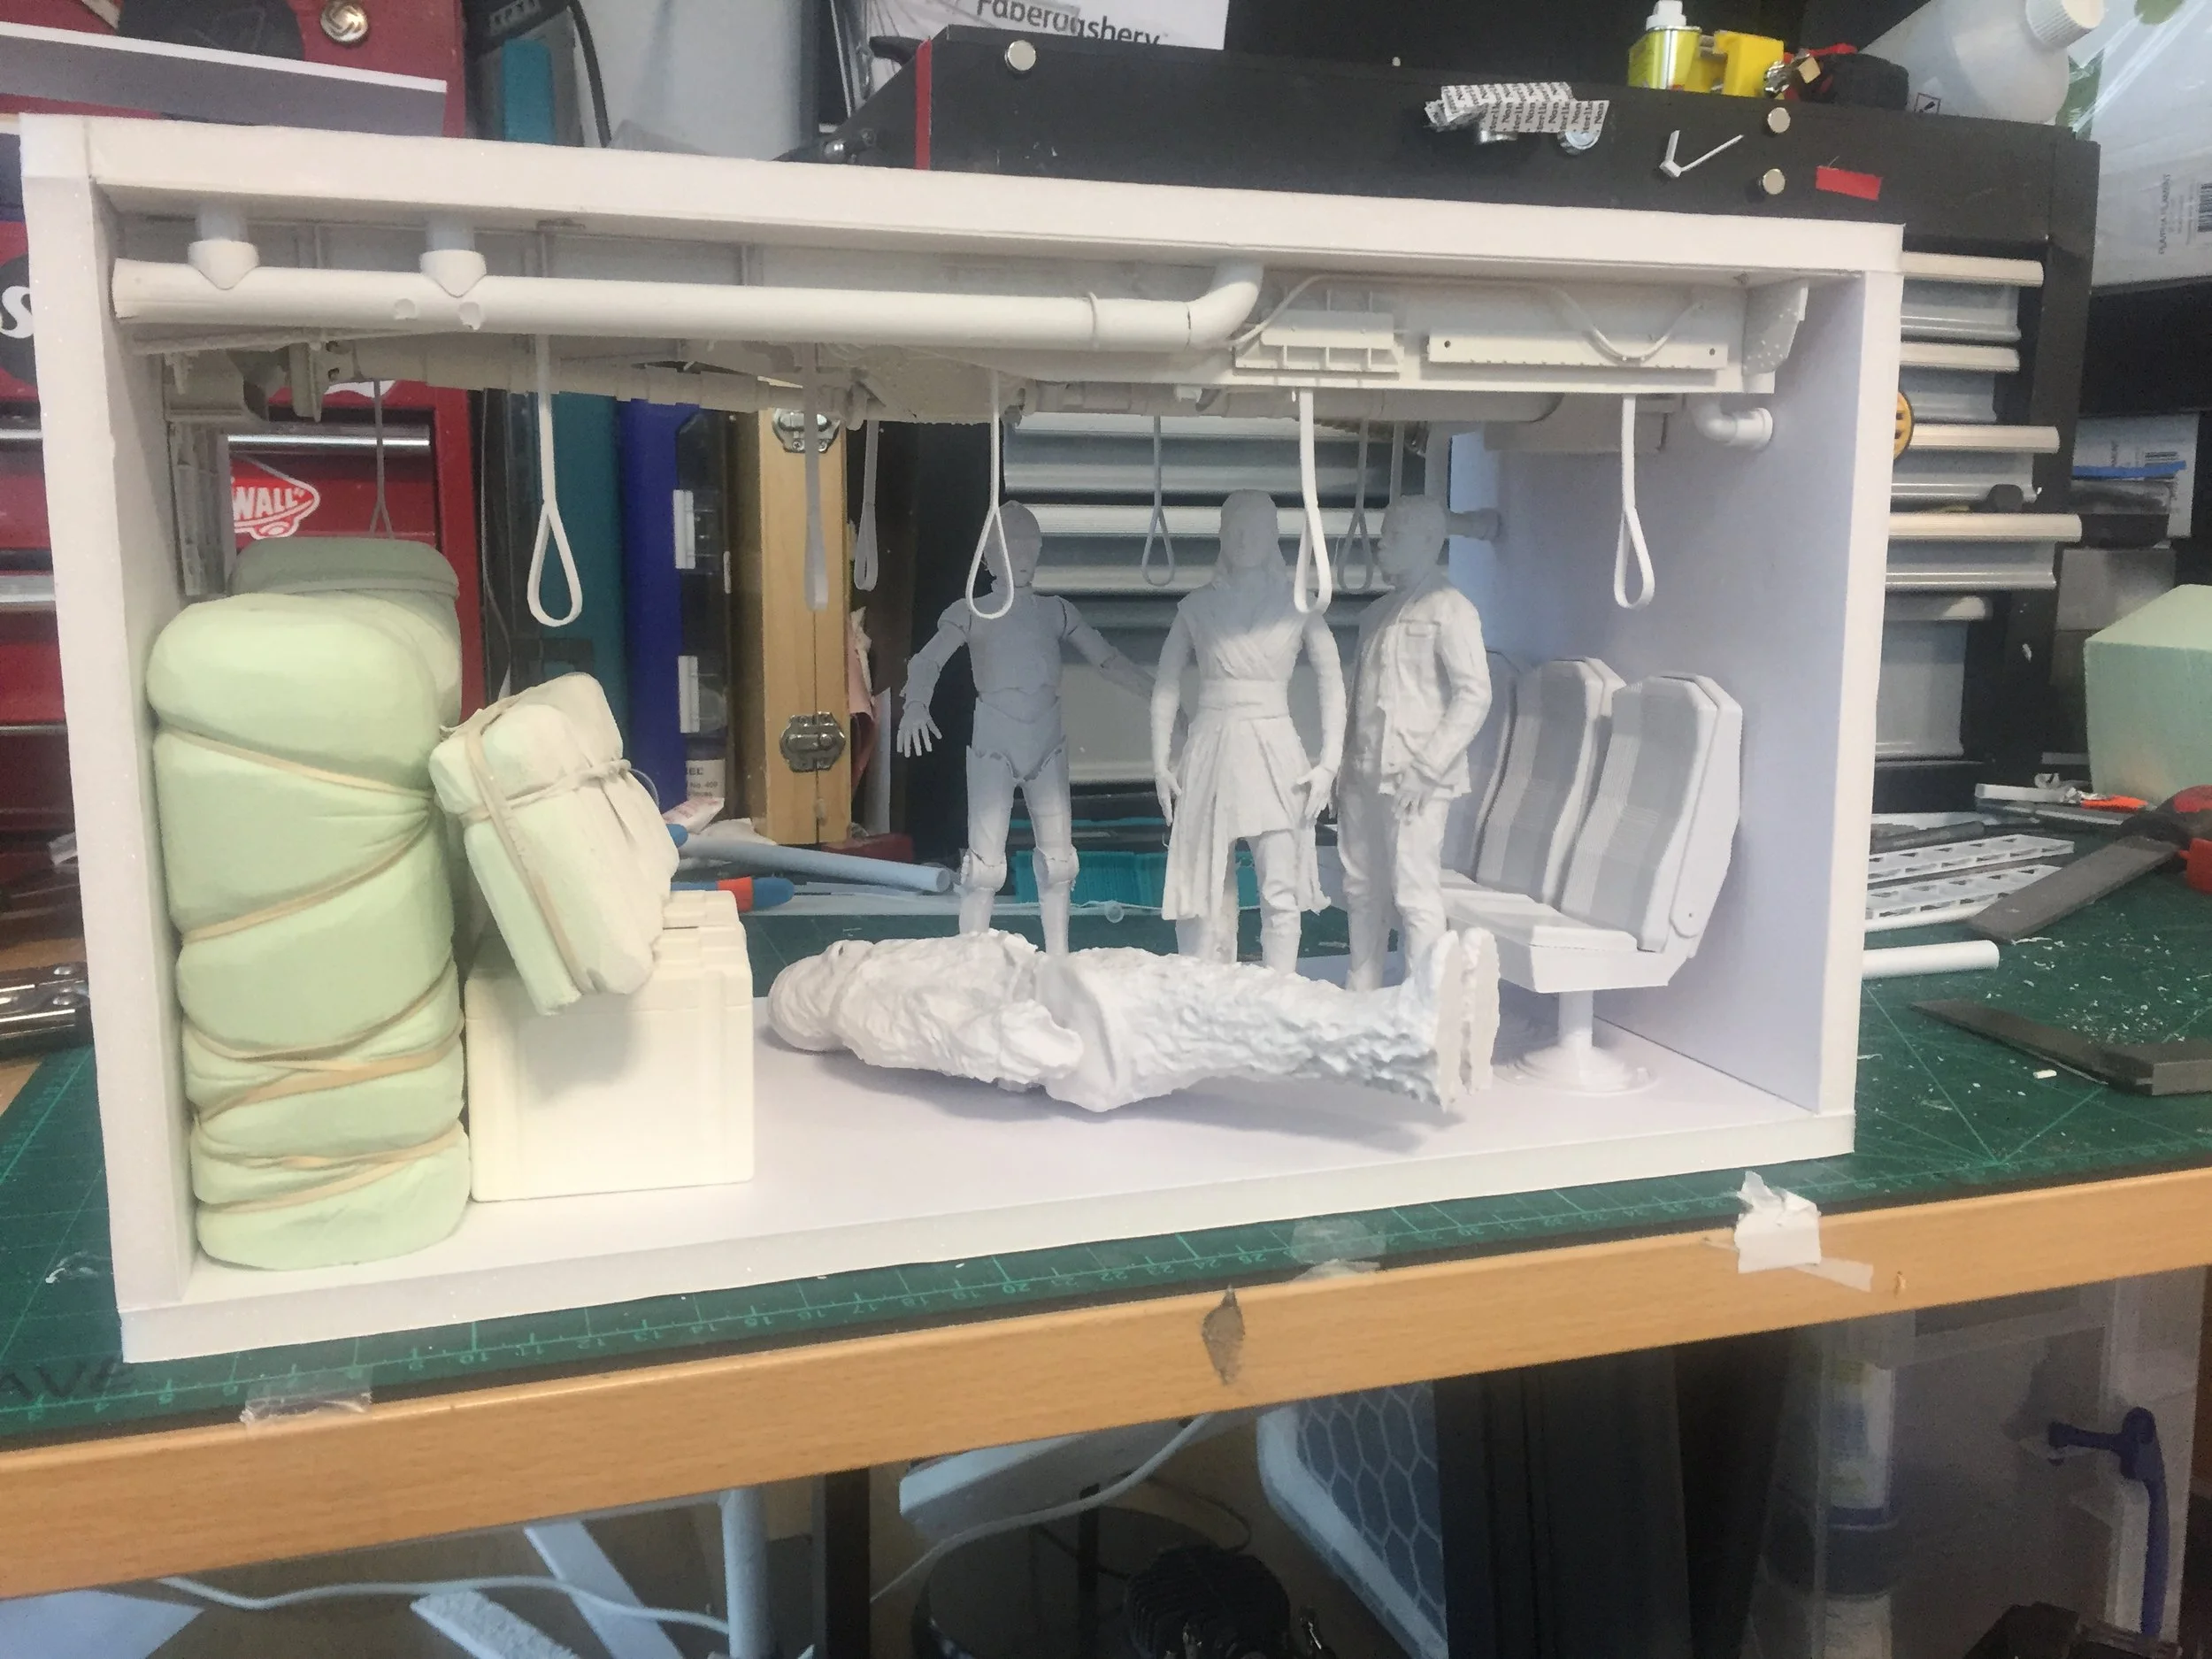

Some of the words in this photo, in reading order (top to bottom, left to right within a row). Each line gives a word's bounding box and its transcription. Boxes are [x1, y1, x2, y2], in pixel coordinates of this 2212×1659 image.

[1501, 102, 1513, 124] Non
[1525, 103, 1536, 124] Non
[1548, 102, 1559, 124] Non
[1571, 103, 1582, 124] Non
[1594, 103, 1605, 125] Non
